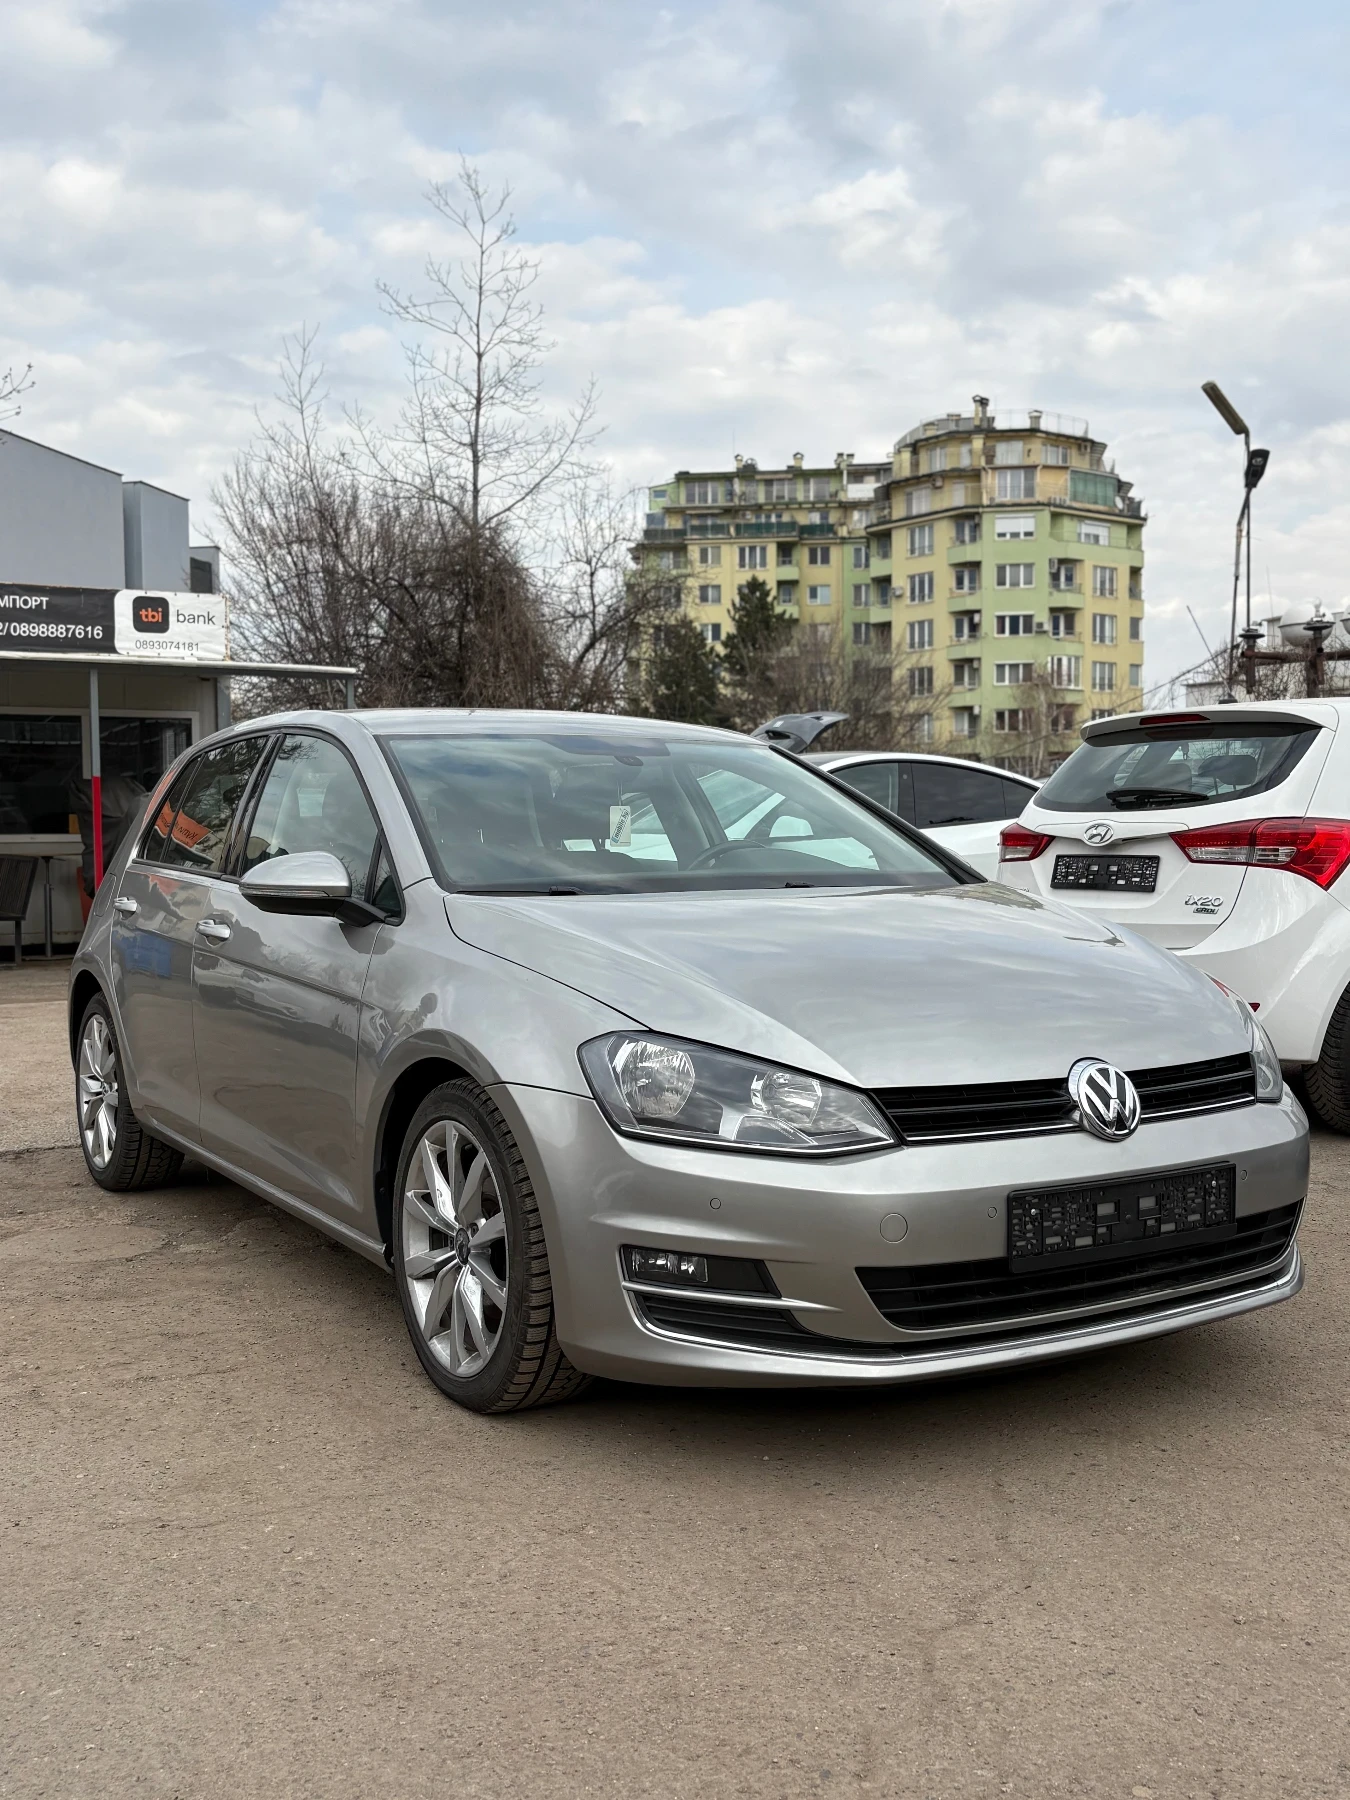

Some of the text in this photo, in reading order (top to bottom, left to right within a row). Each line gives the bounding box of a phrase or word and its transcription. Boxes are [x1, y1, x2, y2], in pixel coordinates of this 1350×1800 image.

[140, 608, 216, 626] tbi bank
[135, 639, 199, 652] 0893074181
